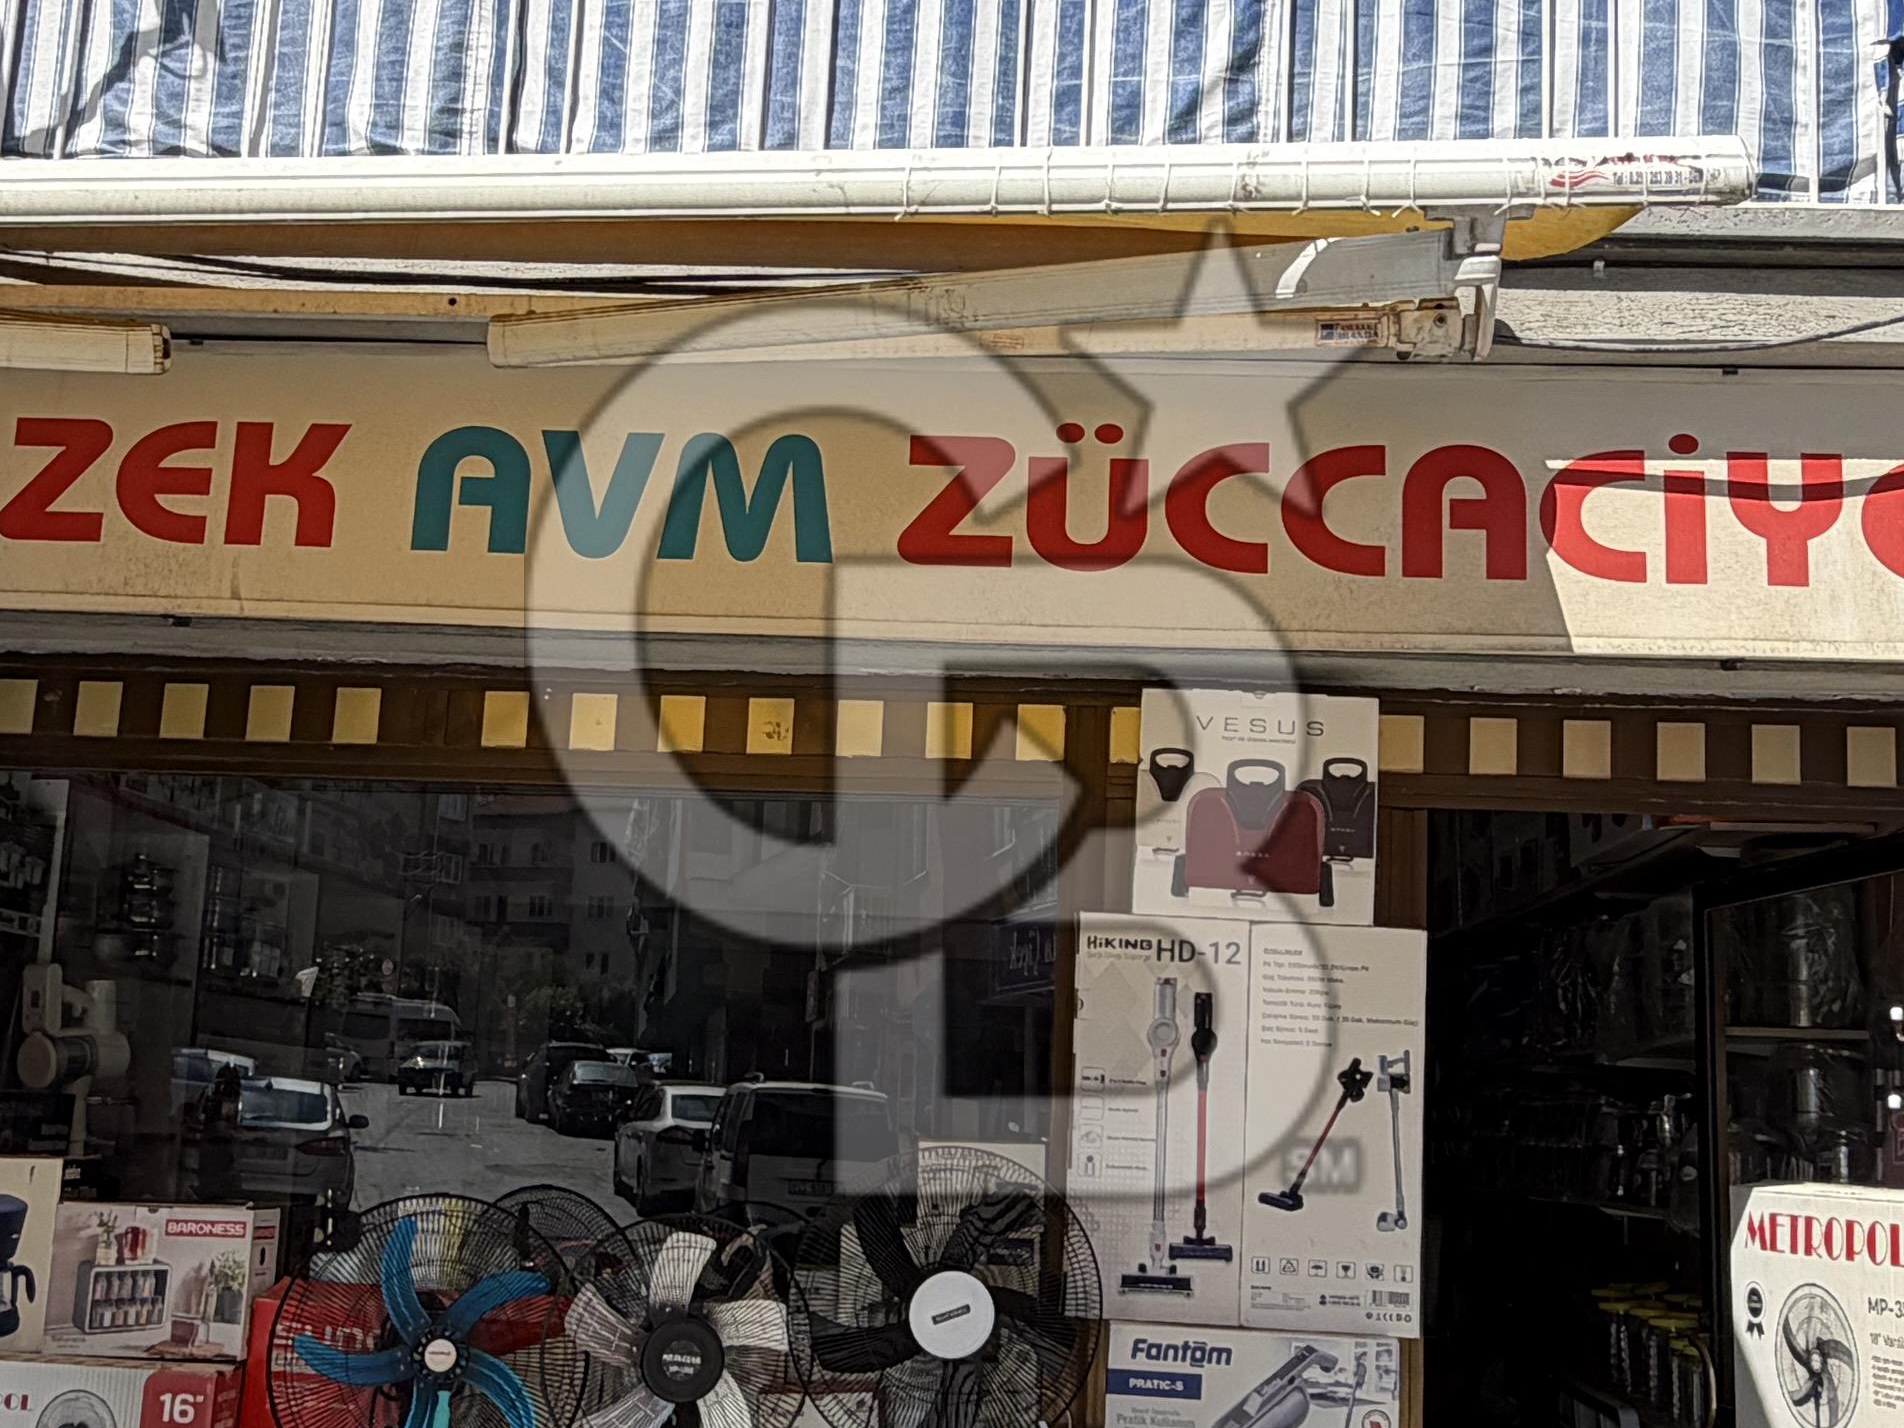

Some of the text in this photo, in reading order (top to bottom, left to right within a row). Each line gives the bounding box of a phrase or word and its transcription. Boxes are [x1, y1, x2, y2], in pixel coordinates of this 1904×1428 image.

[411, 424, 835, 564] AVM
[1197, 715, 1326, 737] VESUS
[1156, 938, 1242, 965] HD-12
[166, 1222, 245, 1236] BARONESS
[159, 1392, 204, 1424] 16"
